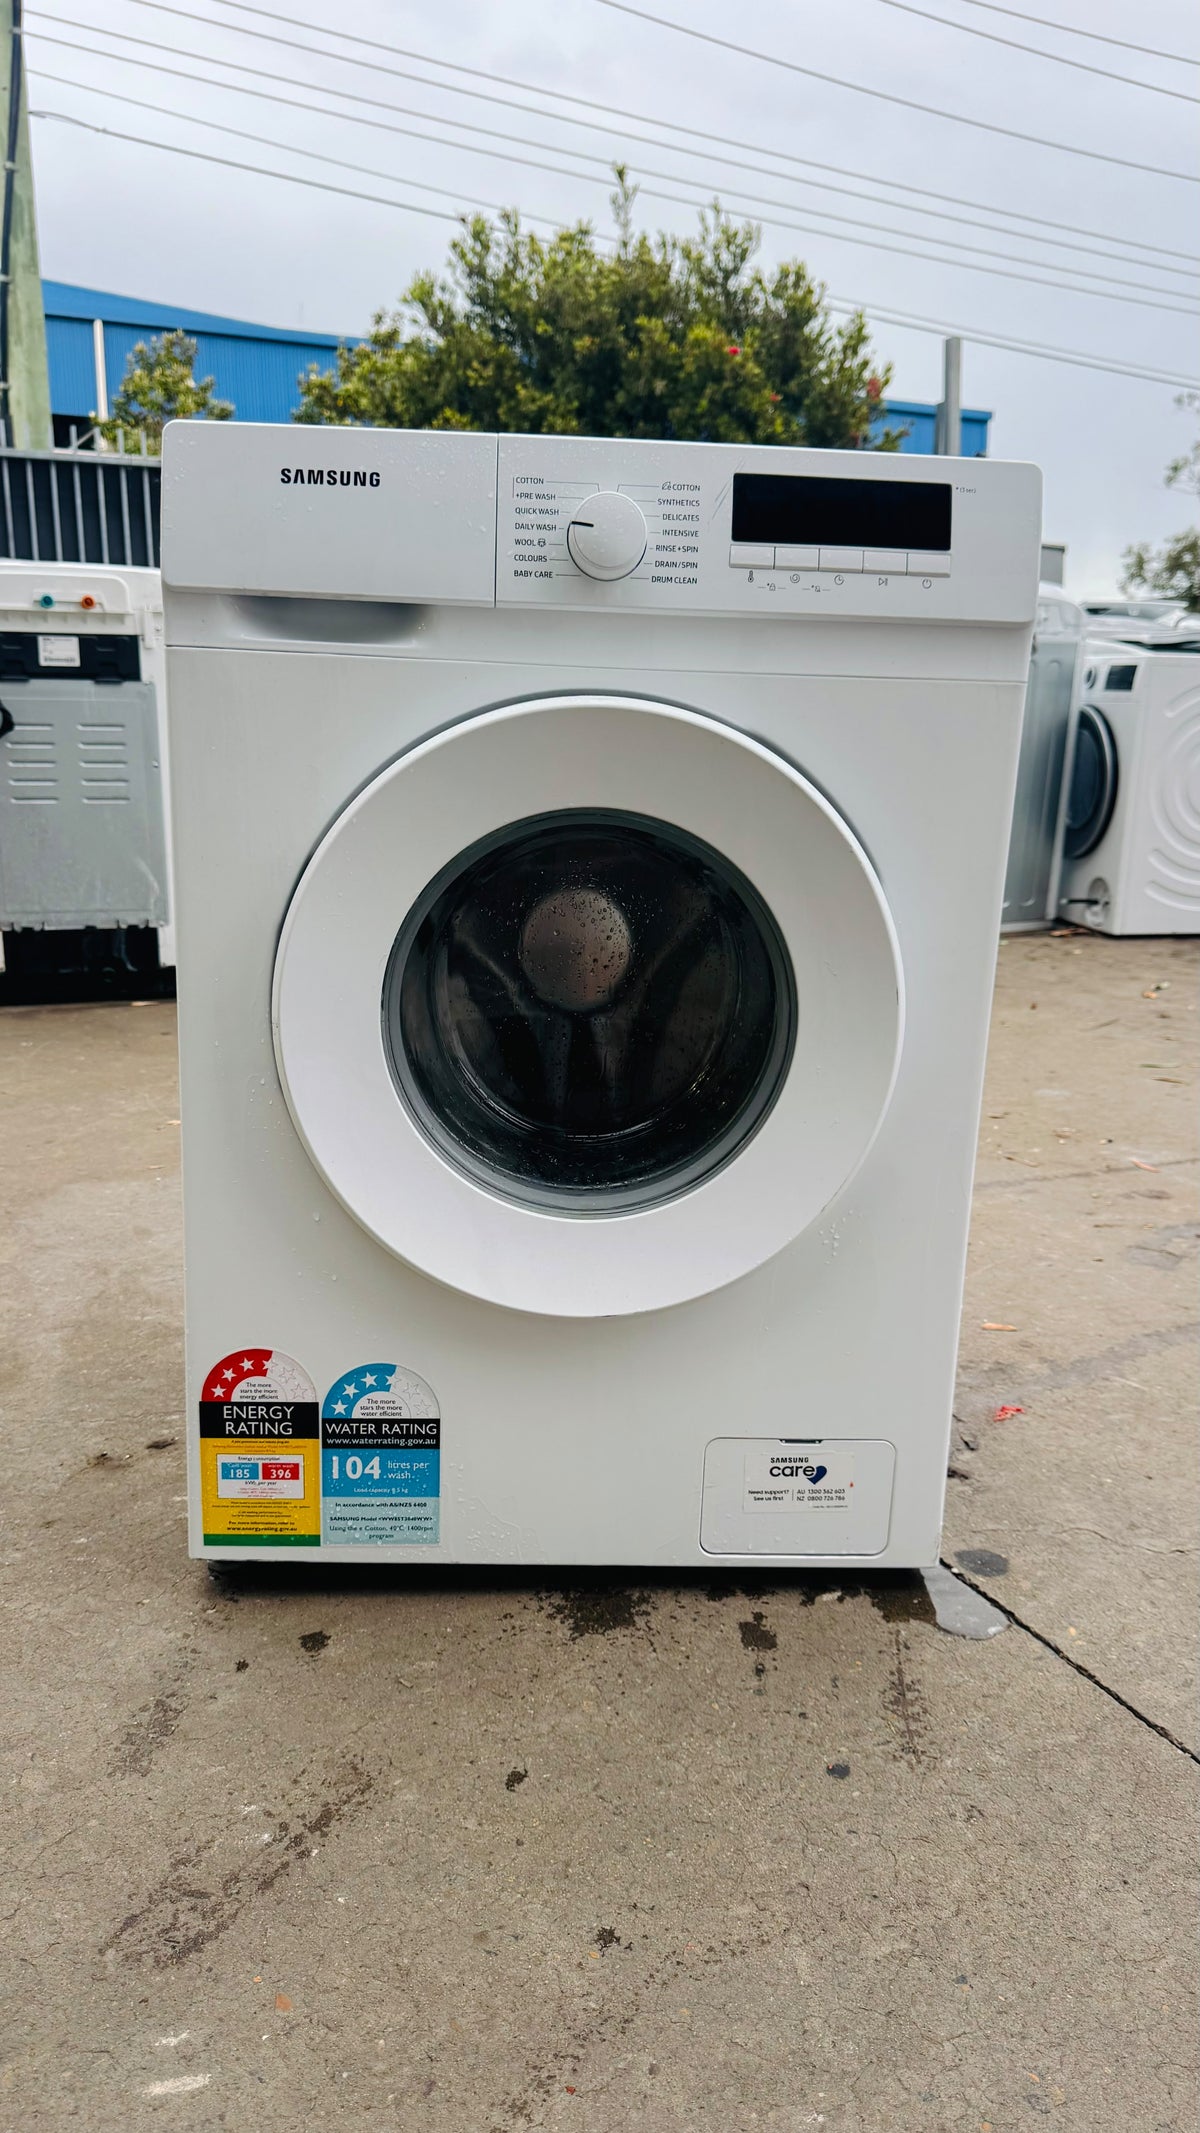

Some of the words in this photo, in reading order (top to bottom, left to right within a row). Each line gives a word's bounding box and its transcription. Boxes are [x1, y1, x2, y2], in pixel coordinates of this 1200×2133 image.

[280, 468, 380, 487] SAMSUNG
[657, 499, 700, 507] SYNTHETICS
[515, 507, 537, 515] QUICK
[515, 522, 535, 530] DAILY
[536, 523, 556, 531] WASH
[662, 529, 699, 537] INTENSIVE
[514, 554, 548, 562] COLOURS
[223, 1405, 294, 1419] ENERGY
[225, 1422, 293, 1435] RATING
[326, 1423, 377, 1435] WATER
[382, 1423, 437, 1435] RATING
[326, 1437, 436, 1446] www.waterrating.gov.au
[332, 1456, 381, 1479] 104
[387, 1460, 410, 1469] litres
[413, 1462, 429, 1471] per
[230, 1469, 250, 1479] 185
[270, 1469, 291, 1479] 396
[388, 1471, 411, 1479] wash
[769, 1465, 815, 1477] care
